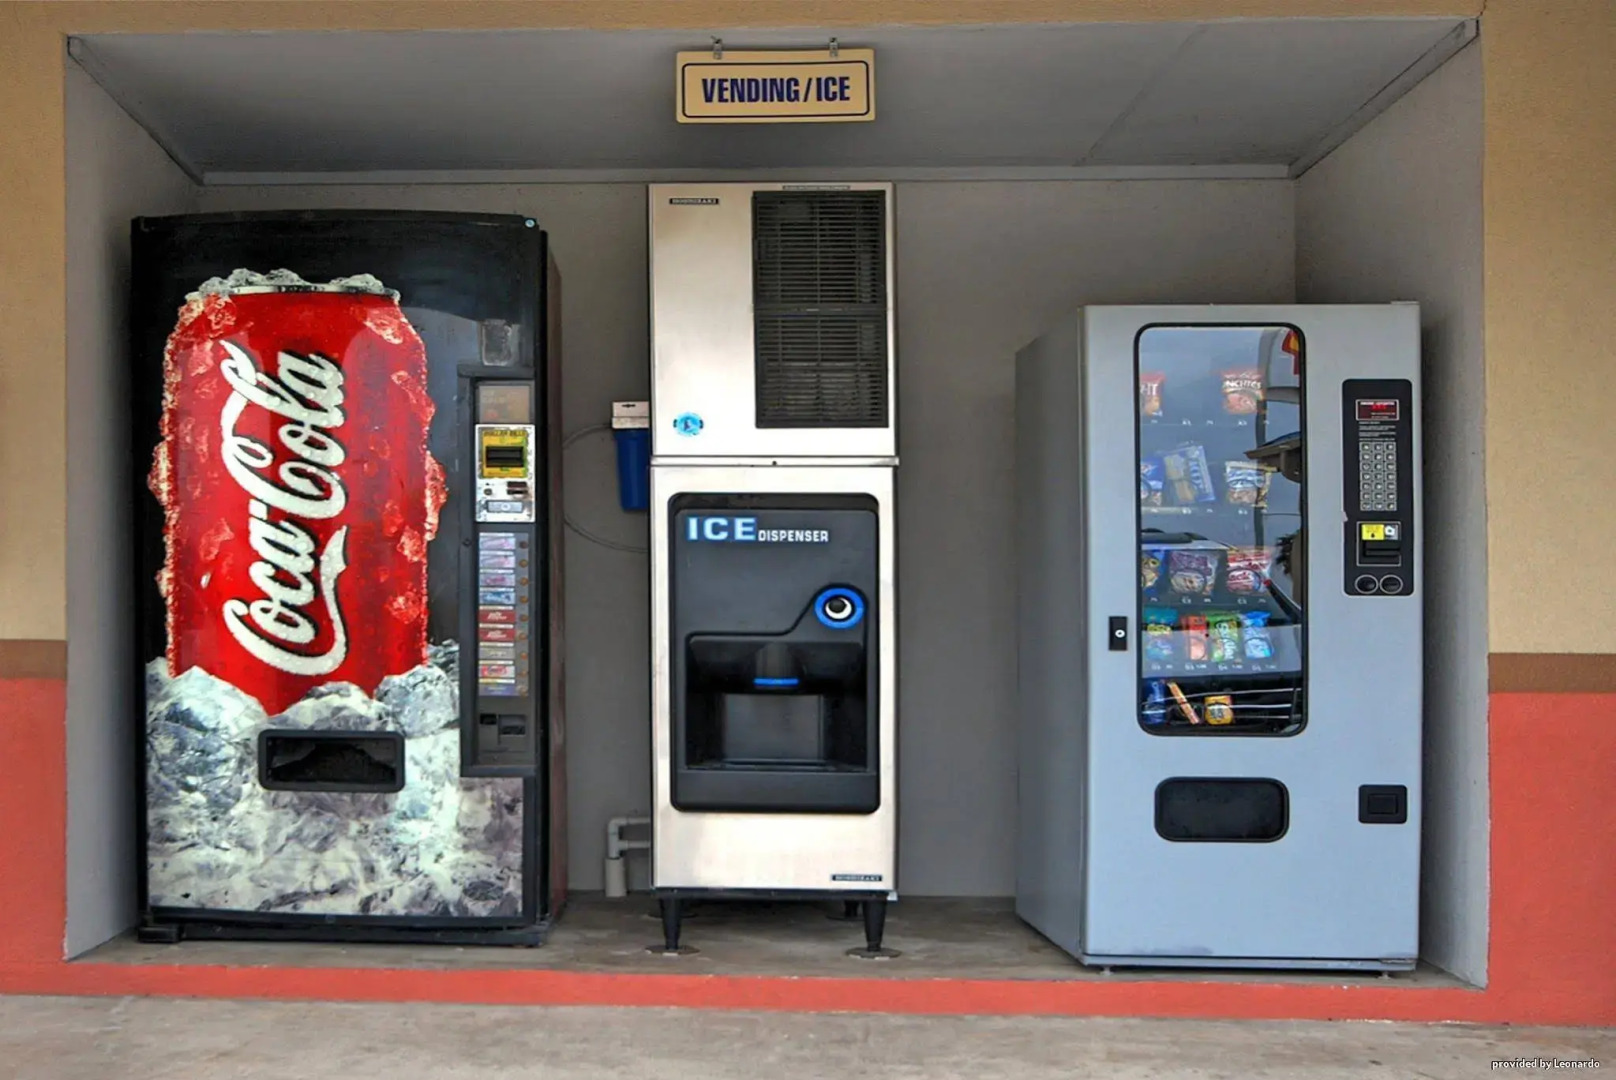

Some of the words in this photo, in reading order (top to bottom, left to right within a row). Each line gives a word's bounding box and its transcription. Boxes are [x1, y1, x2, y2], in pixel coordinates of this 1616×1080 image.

[701, 76, 851, 103] VENDING/ICE
[219, 338, 349, 677] Coca-Cola
[687, 516, 757, 541] ICE
[757, 529, 830, 543] DISPENSER
